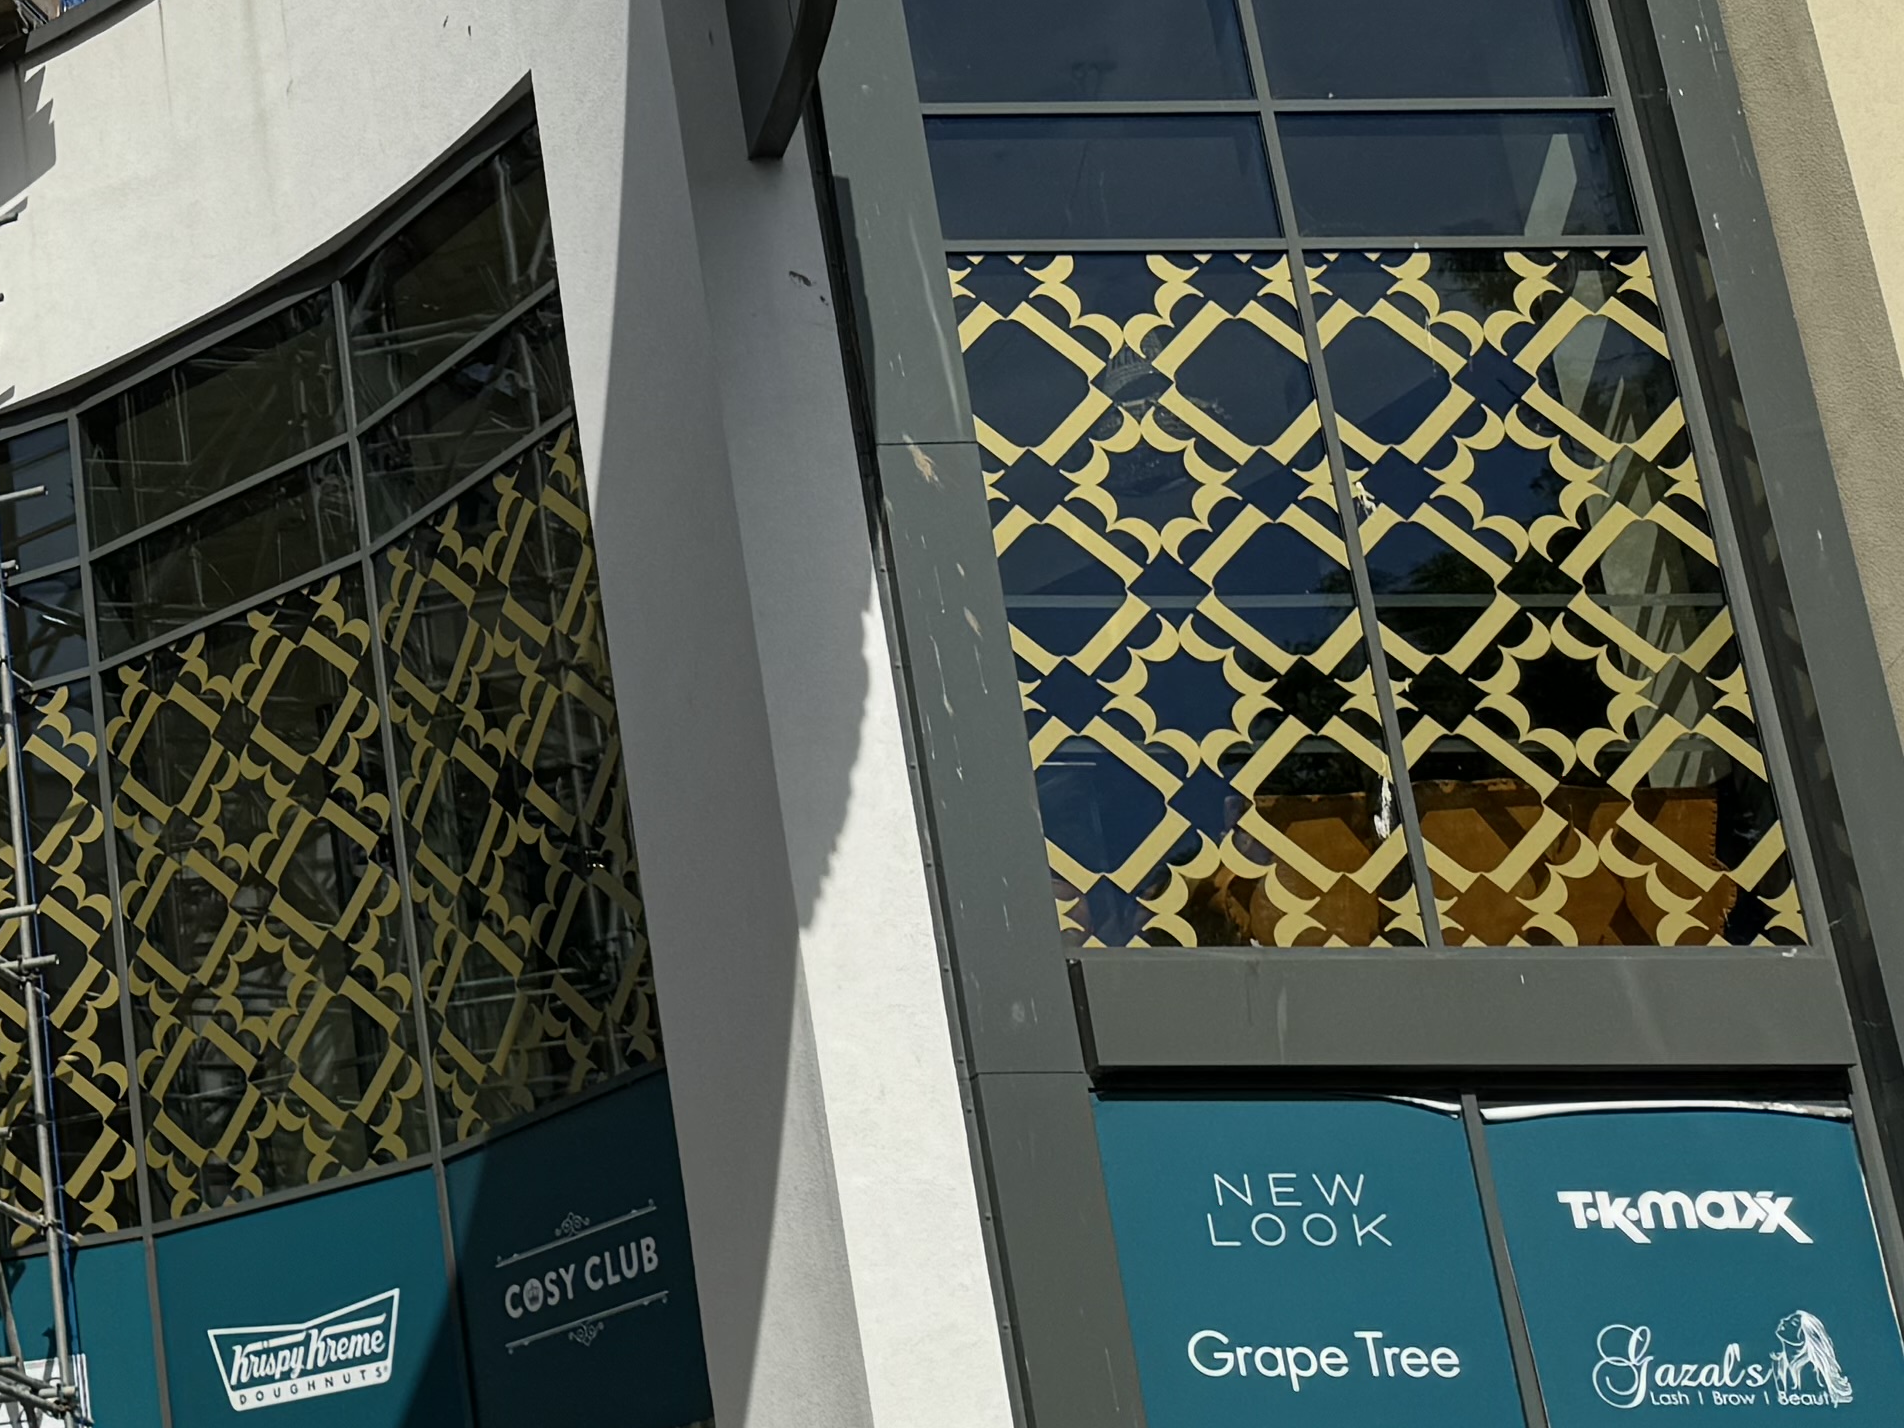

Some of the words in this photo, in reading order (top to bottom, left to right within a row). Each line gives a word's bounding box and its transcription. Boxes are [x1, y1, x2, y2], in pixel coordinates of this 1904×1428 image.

[1213, 1173, 1367, 1207] NEW
[1206, 1213, 1392, 1247] LOOK
[505, 1264, 575, 1319] COSY
[584, 1236, 658, 1291] CLUB
[230, 1330, 306, 1386] Krispy
[306, 1313, 387, 1370] Kreme
[1188, 1329, 1350, 1391] Grape
[1354, 1331, 1461, 1379] Tree
[239, 1367, 383, 1405] DOUGHNUTS
[1649, 1390, 1690, 1405] Lash
[1712, 1390, 1755, 1406] Brow
[1778, 1390, 1840, 1408] Beauty
